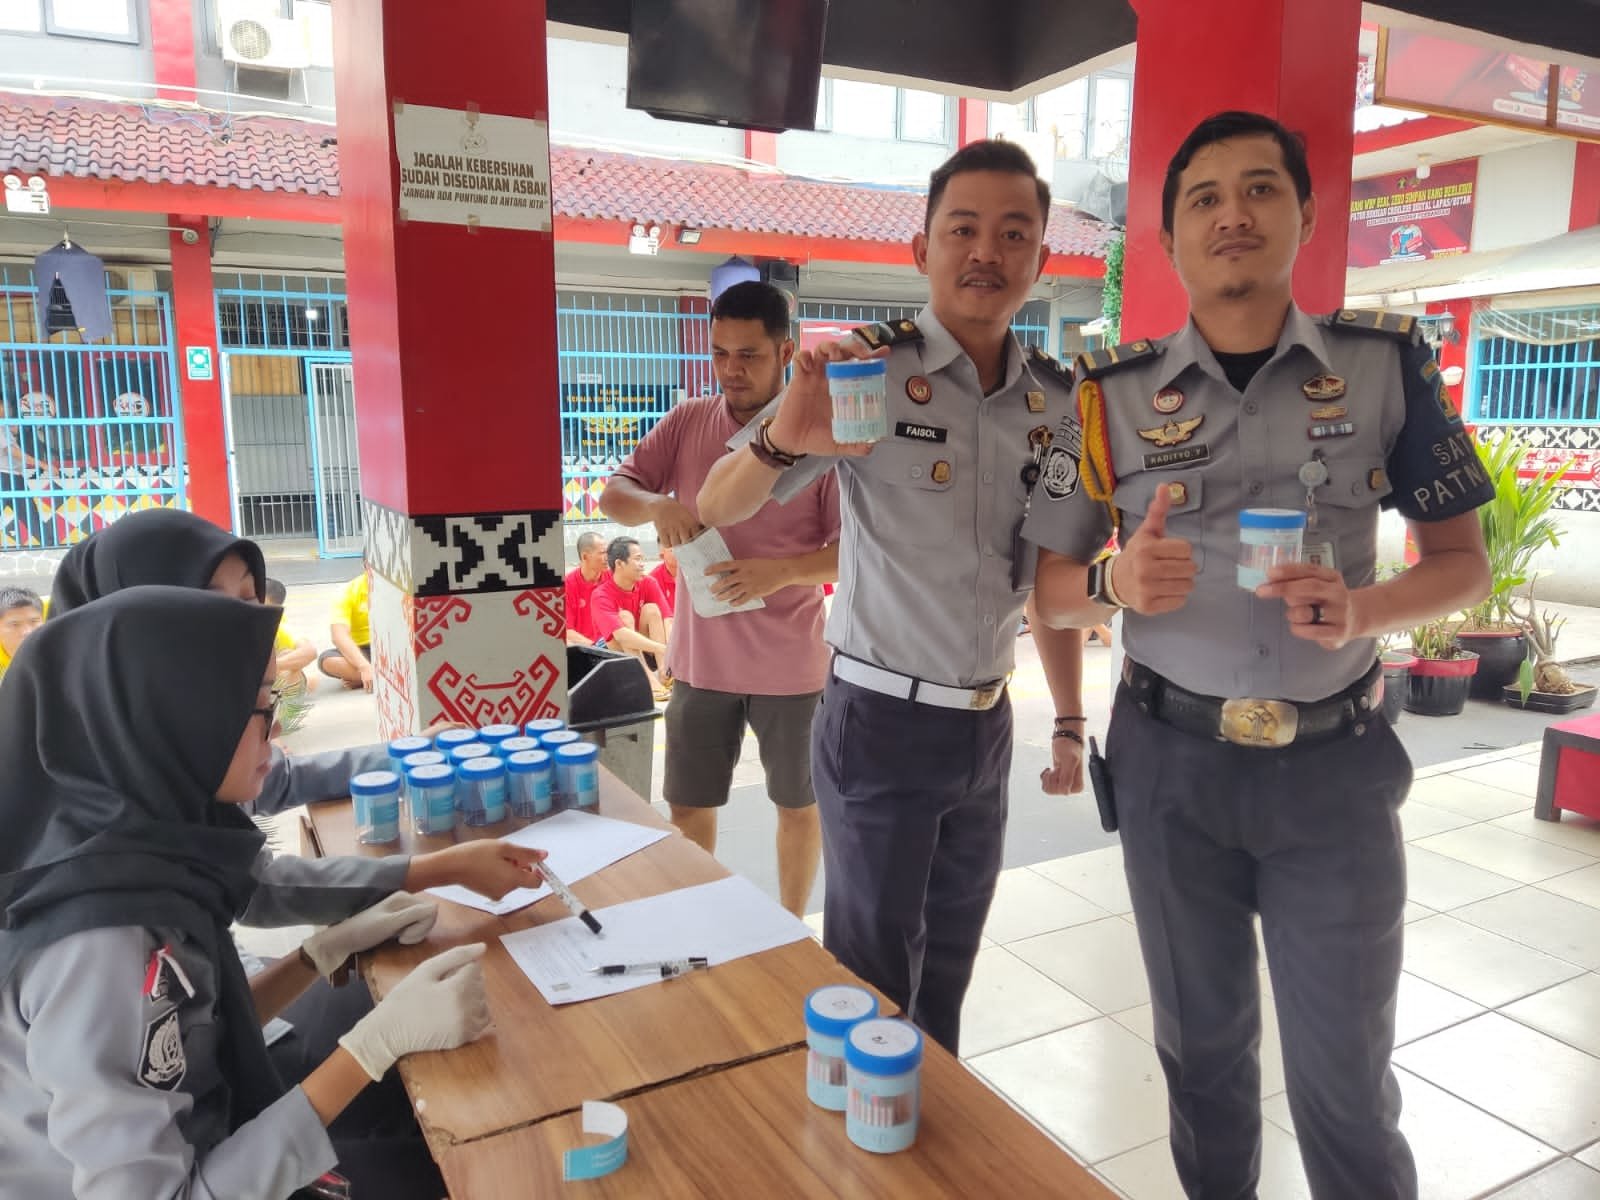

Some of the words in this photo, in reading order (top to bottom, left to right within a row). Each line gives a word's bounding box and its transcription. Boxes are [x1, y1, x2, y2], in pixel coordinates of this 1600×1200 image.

[414, 152, 463, 171] JAGALAH
[466, 158, 534, 178] KEBERSIHAN
[402, 168, 439, 186] SUDAH
[443, 172, 510, 192] DISEDIAKAN
[512, 180, 547, 196] ASBAK
[437, 191, 452, 201] ADA
[455, 192, 488, 205] PUNTUNG
[490, 196, 498, 205] DI
[500, 197, 527, 208] ANTARA
[906, 426, 936, 438] FAISOL
